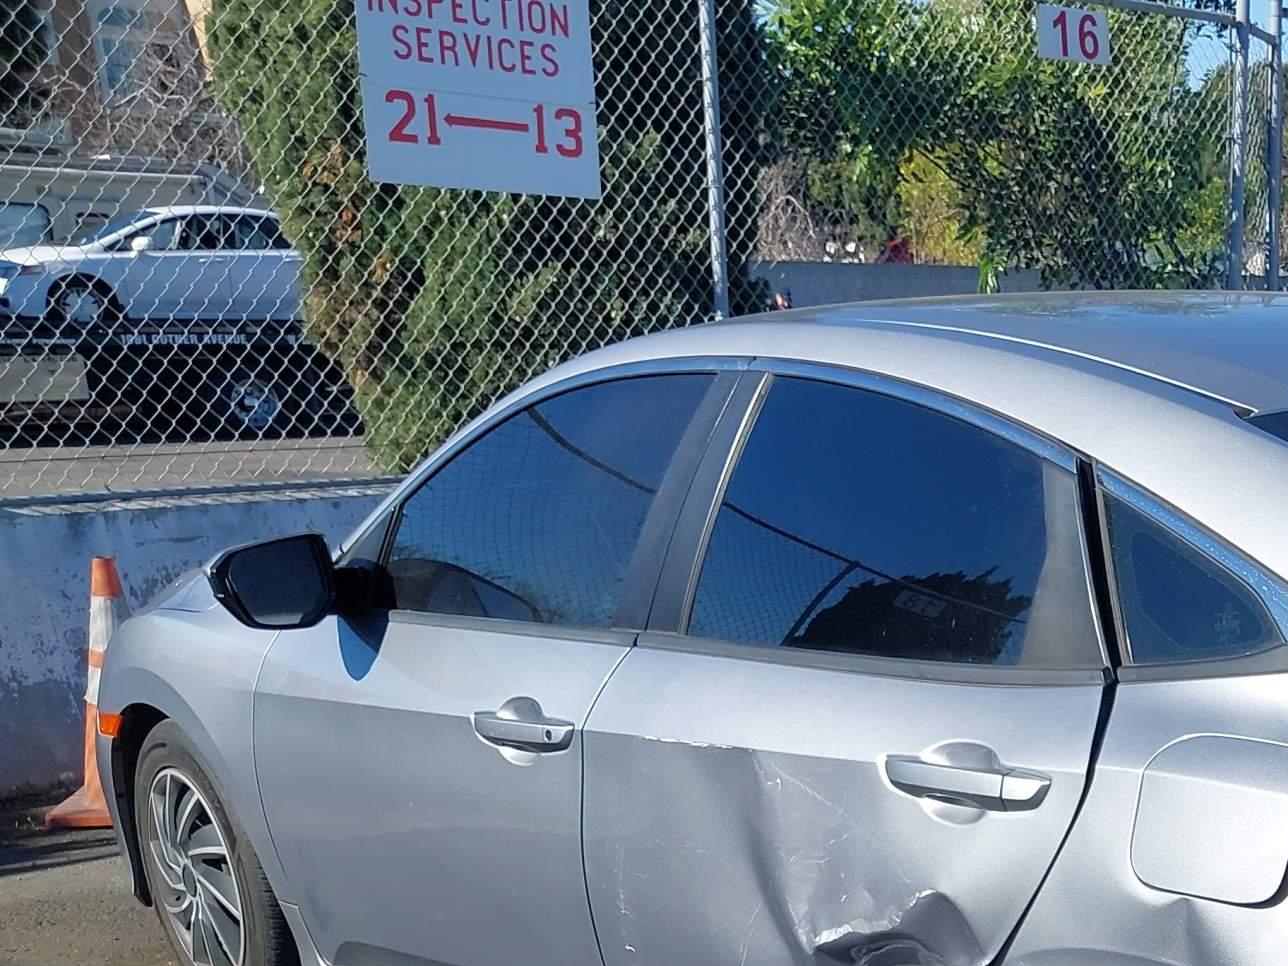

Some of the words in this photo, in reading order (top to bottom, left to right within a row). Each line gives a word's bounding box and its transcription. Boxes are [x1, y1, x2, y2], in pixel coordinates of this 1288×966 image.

[391, 24, 560, 78] SERVICES
[1052, 10, 1100, 60] 16
[384, 89, 442, 146] 21
[532, 103, 584, 158] 13
